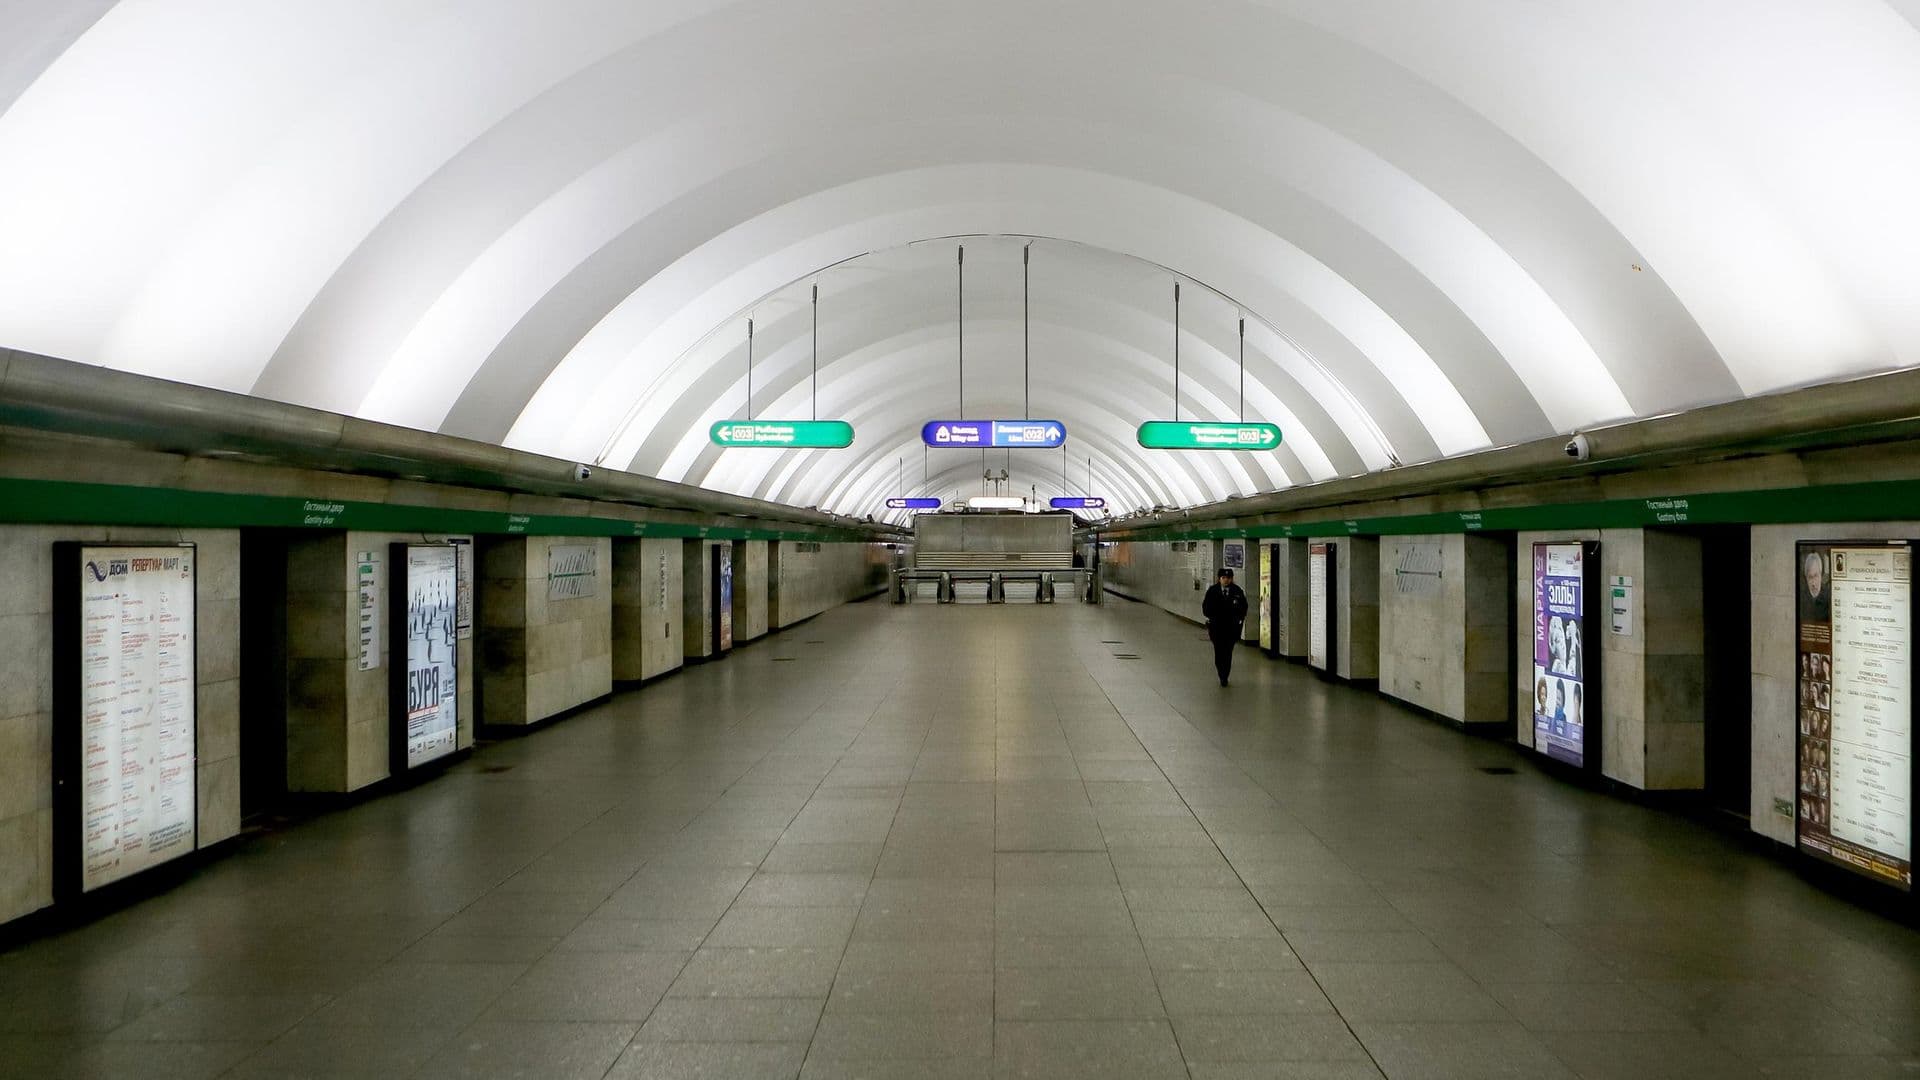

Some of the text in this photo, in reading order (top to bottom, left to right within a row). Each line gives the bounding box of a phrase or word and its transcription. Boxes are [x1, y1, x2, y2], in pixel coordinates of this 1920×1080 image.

[109, 564, 128, 577] ДОМ
[132, 557, 179, 572] РЕПЕРТУАР МАРТ
[1548, 585, 1576, 606] ЭЛЛЫ
[1536, 576, 1545, 641] МАРТА
[408, 665, 439, 713] БУРЯ
